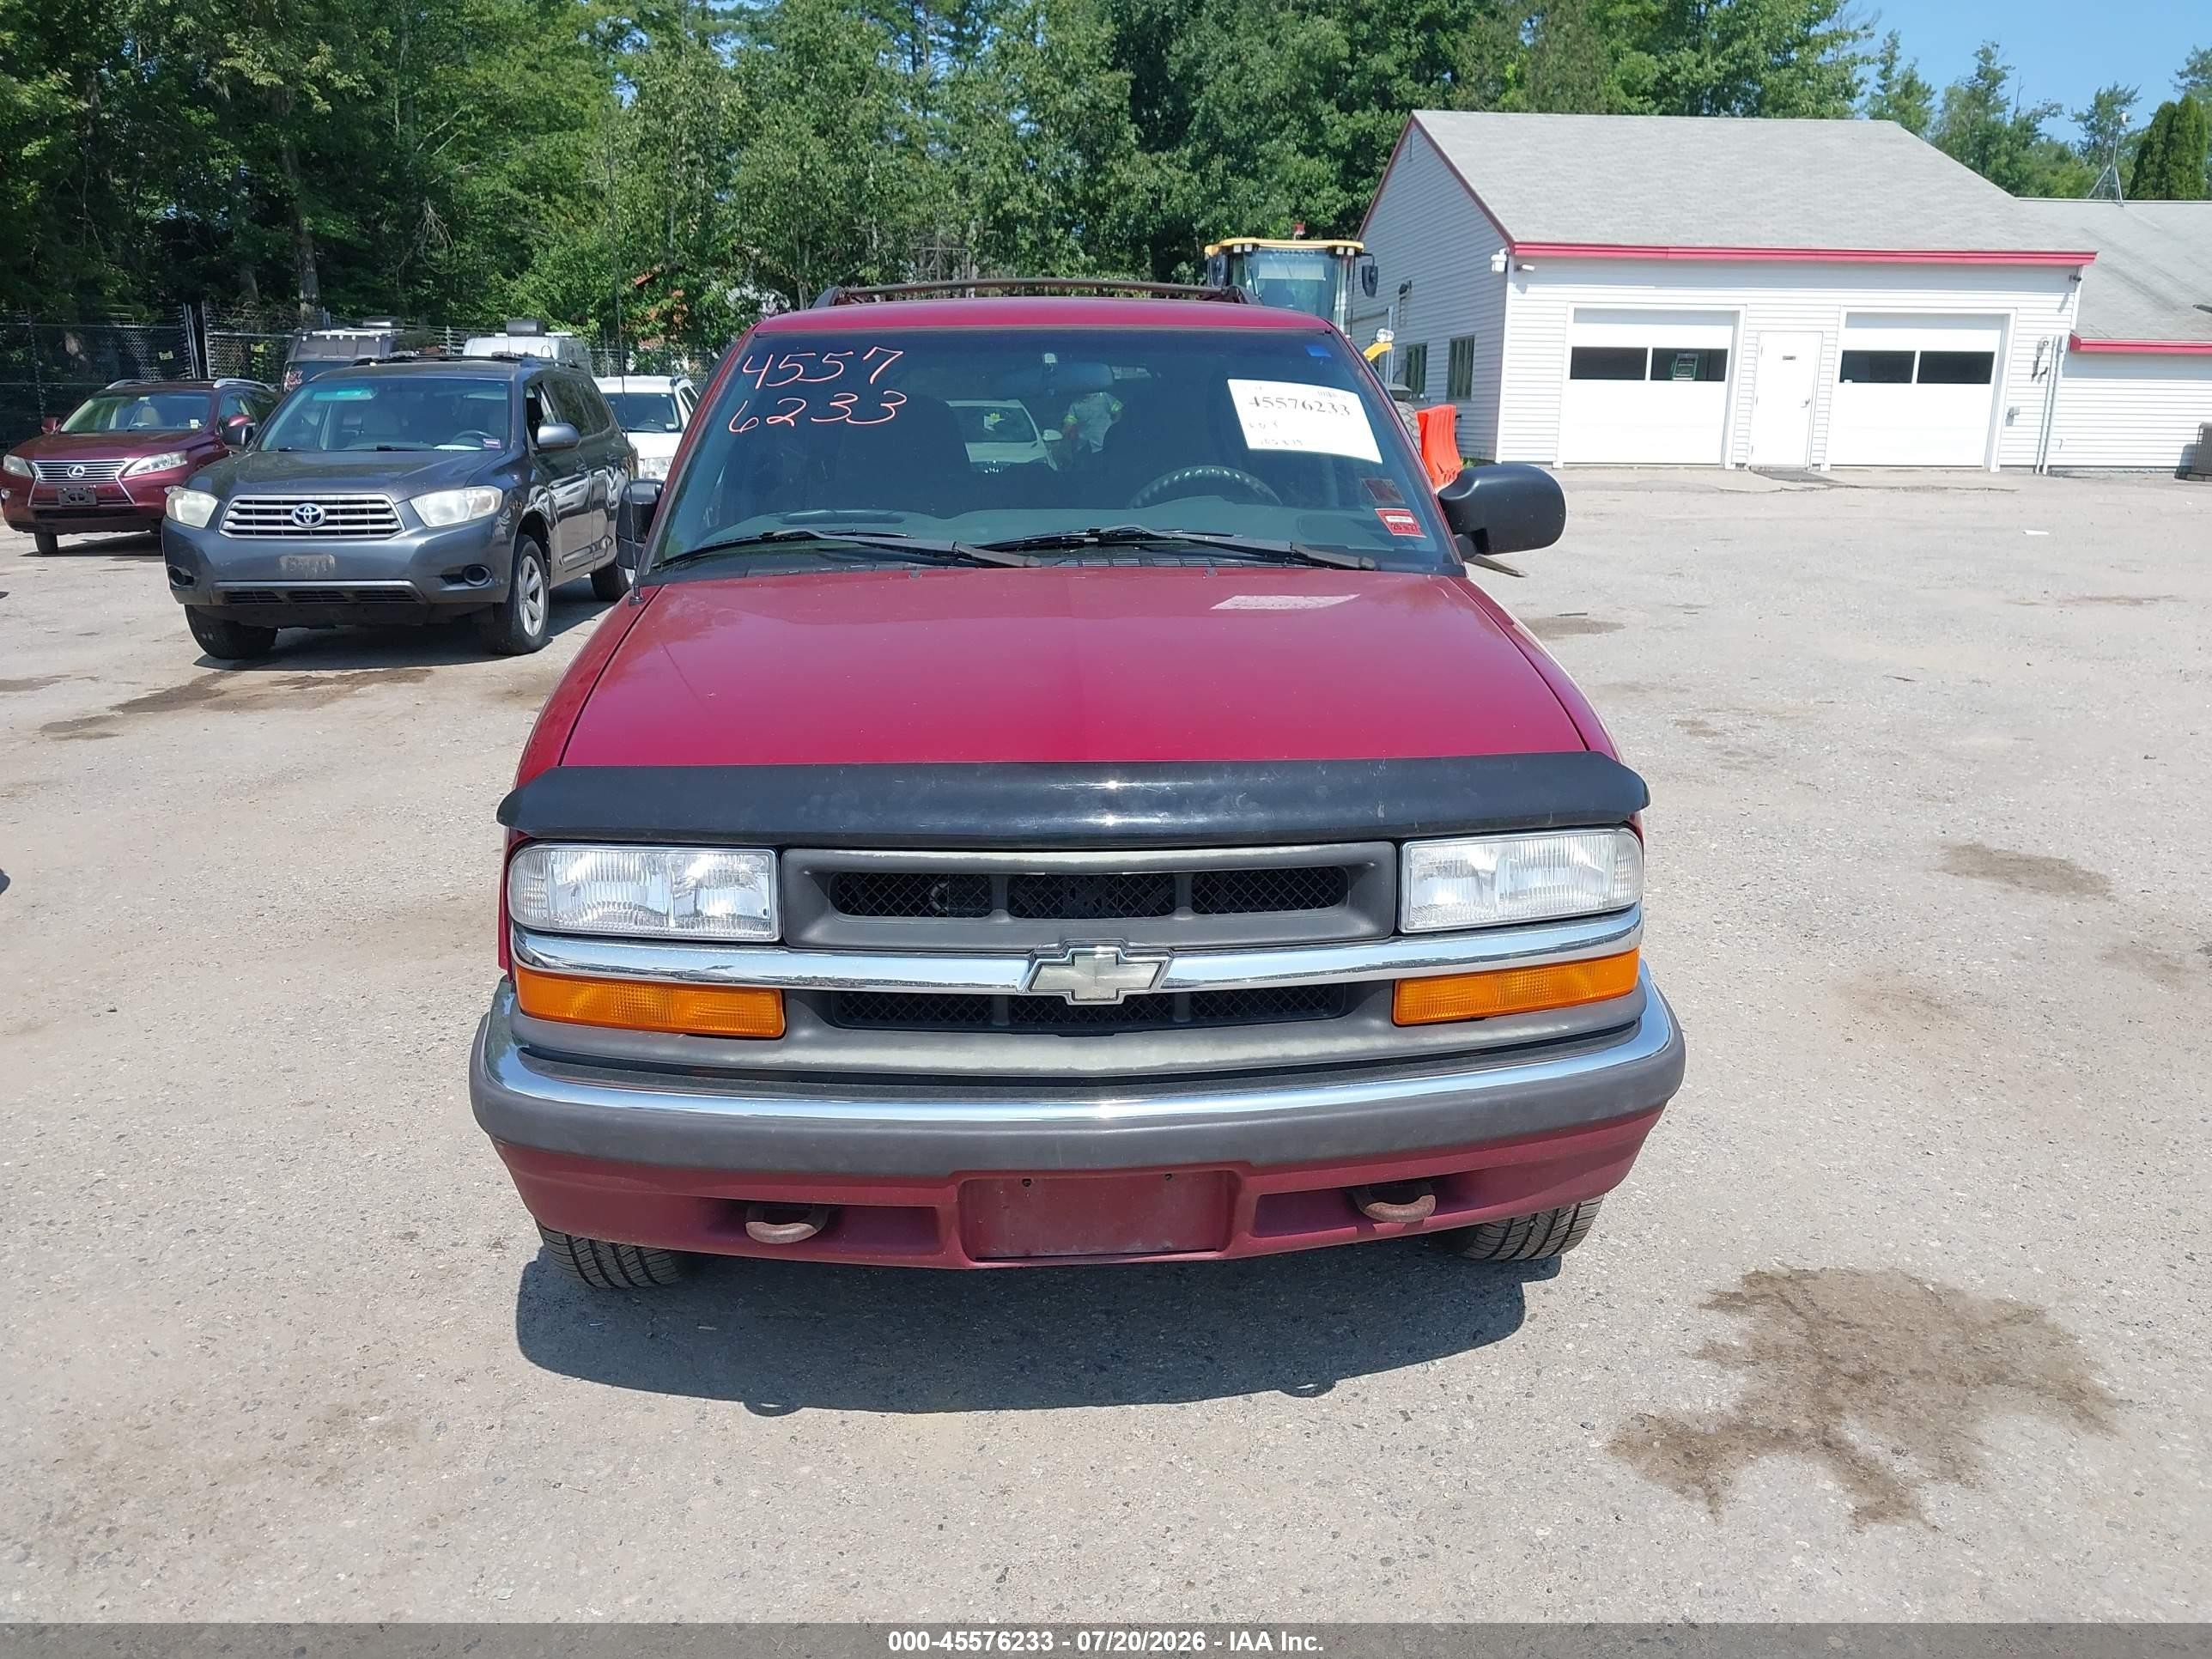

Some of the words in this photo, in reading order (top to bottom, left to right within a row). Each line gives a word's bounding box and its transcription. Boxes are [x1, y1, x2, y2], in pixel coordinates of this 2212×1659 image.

[742, 346, 903, 390] 4557
[728, 390, 907, 433] 6233
[1248, 396, 1351, 416] 45576233
